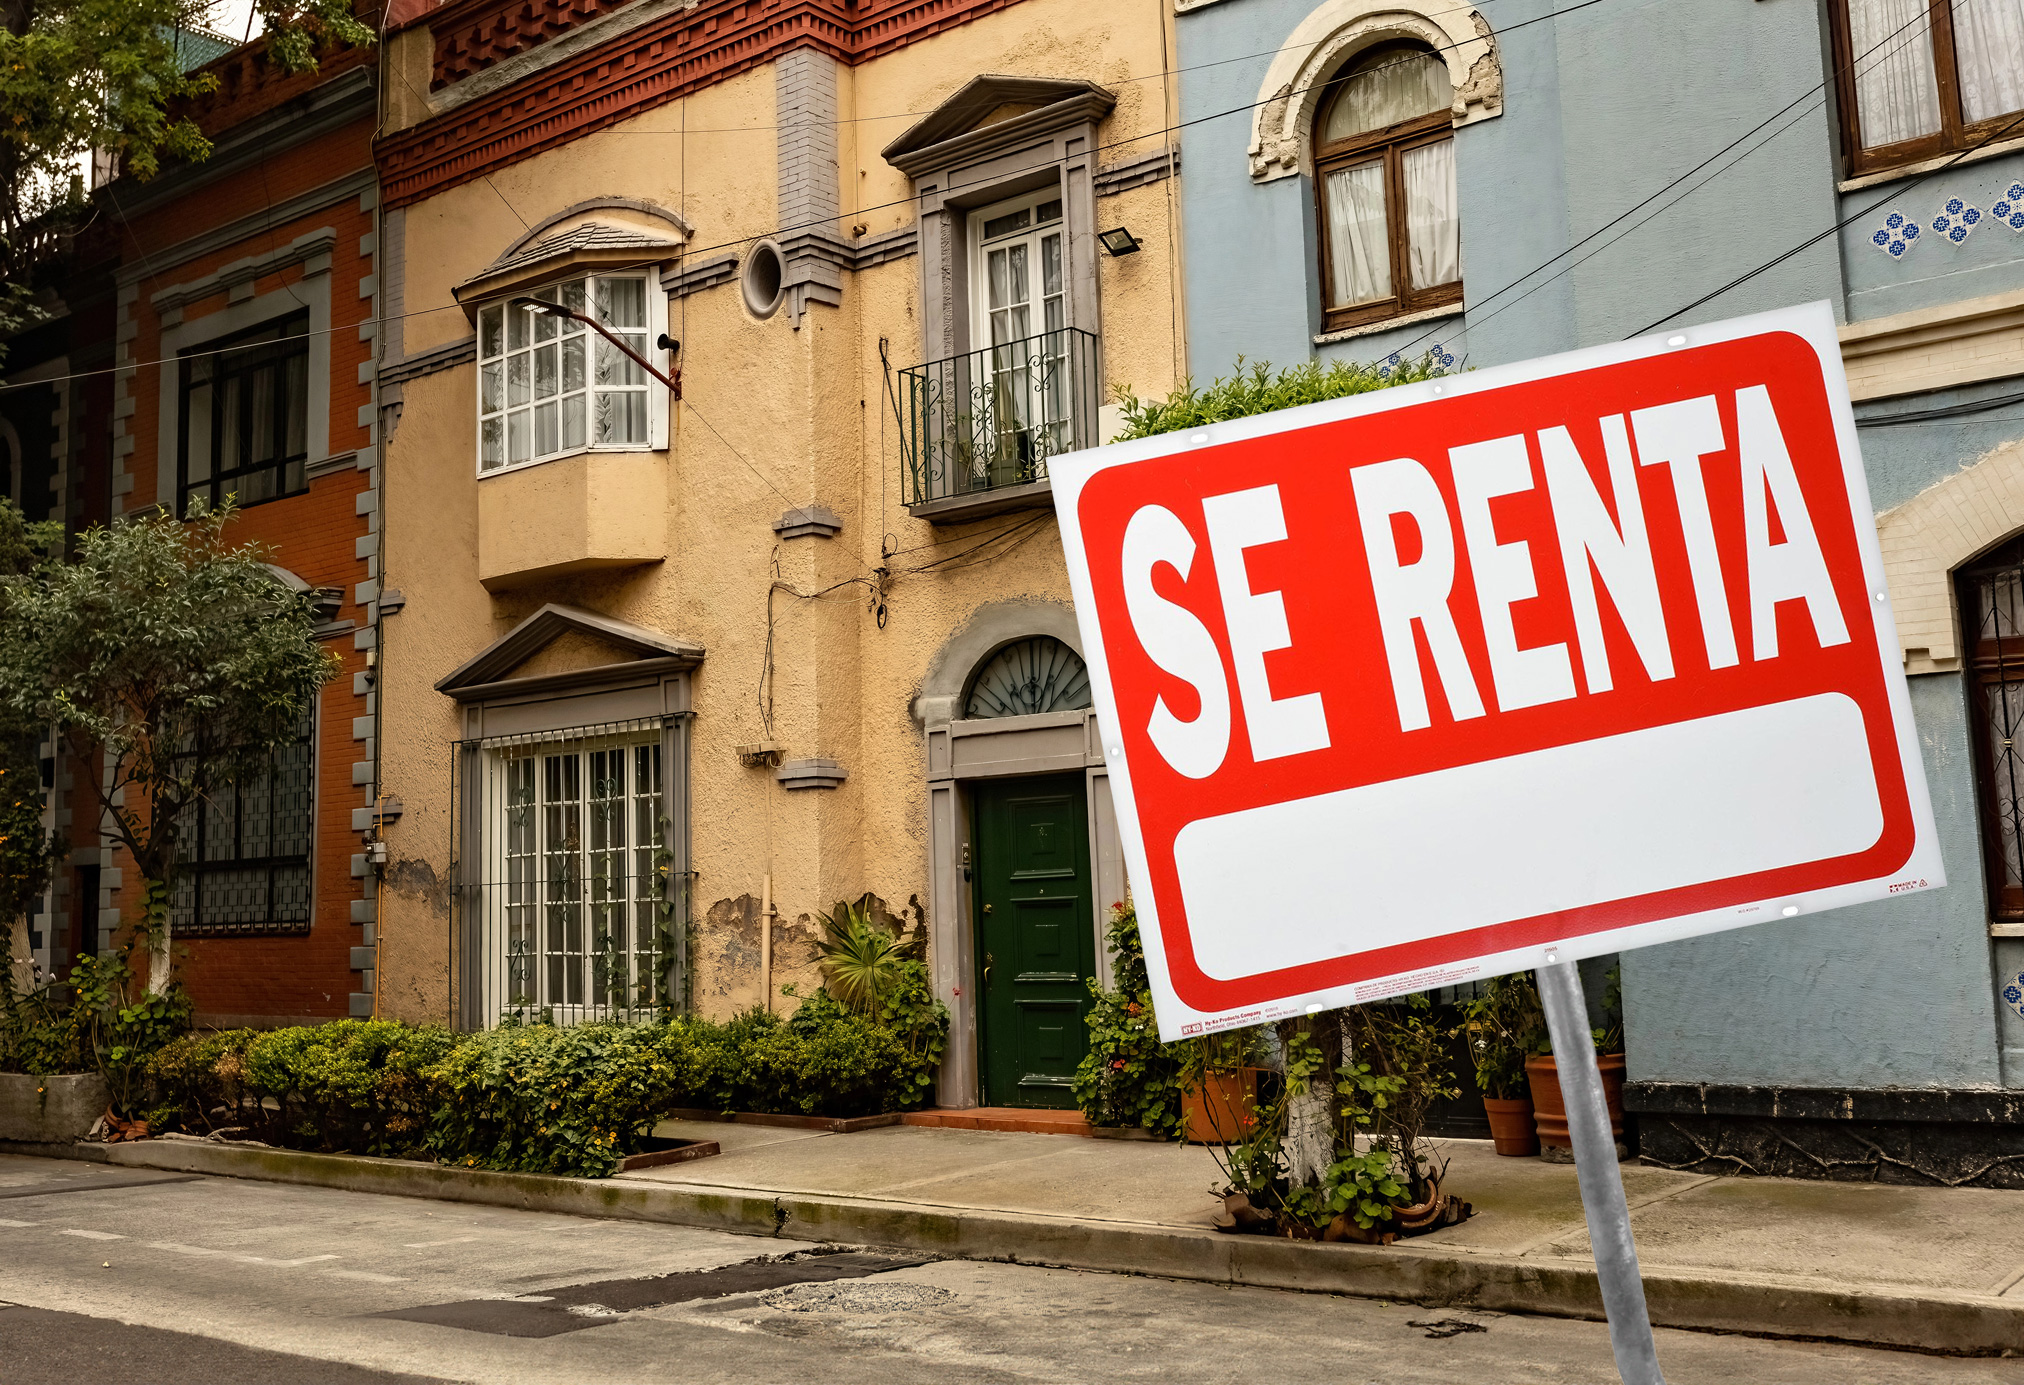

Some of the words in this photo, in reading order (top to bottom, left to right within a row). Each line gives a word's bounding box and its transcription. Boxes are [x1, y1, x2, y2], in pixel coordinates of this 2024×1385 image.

[1122, 484, 1331, 779] SE
[1350, 384, 1851, 732] RENTA
[1241, 1010, 1261, 1018] Company
[1182, 1024, 1201, 1034] HY-KO
